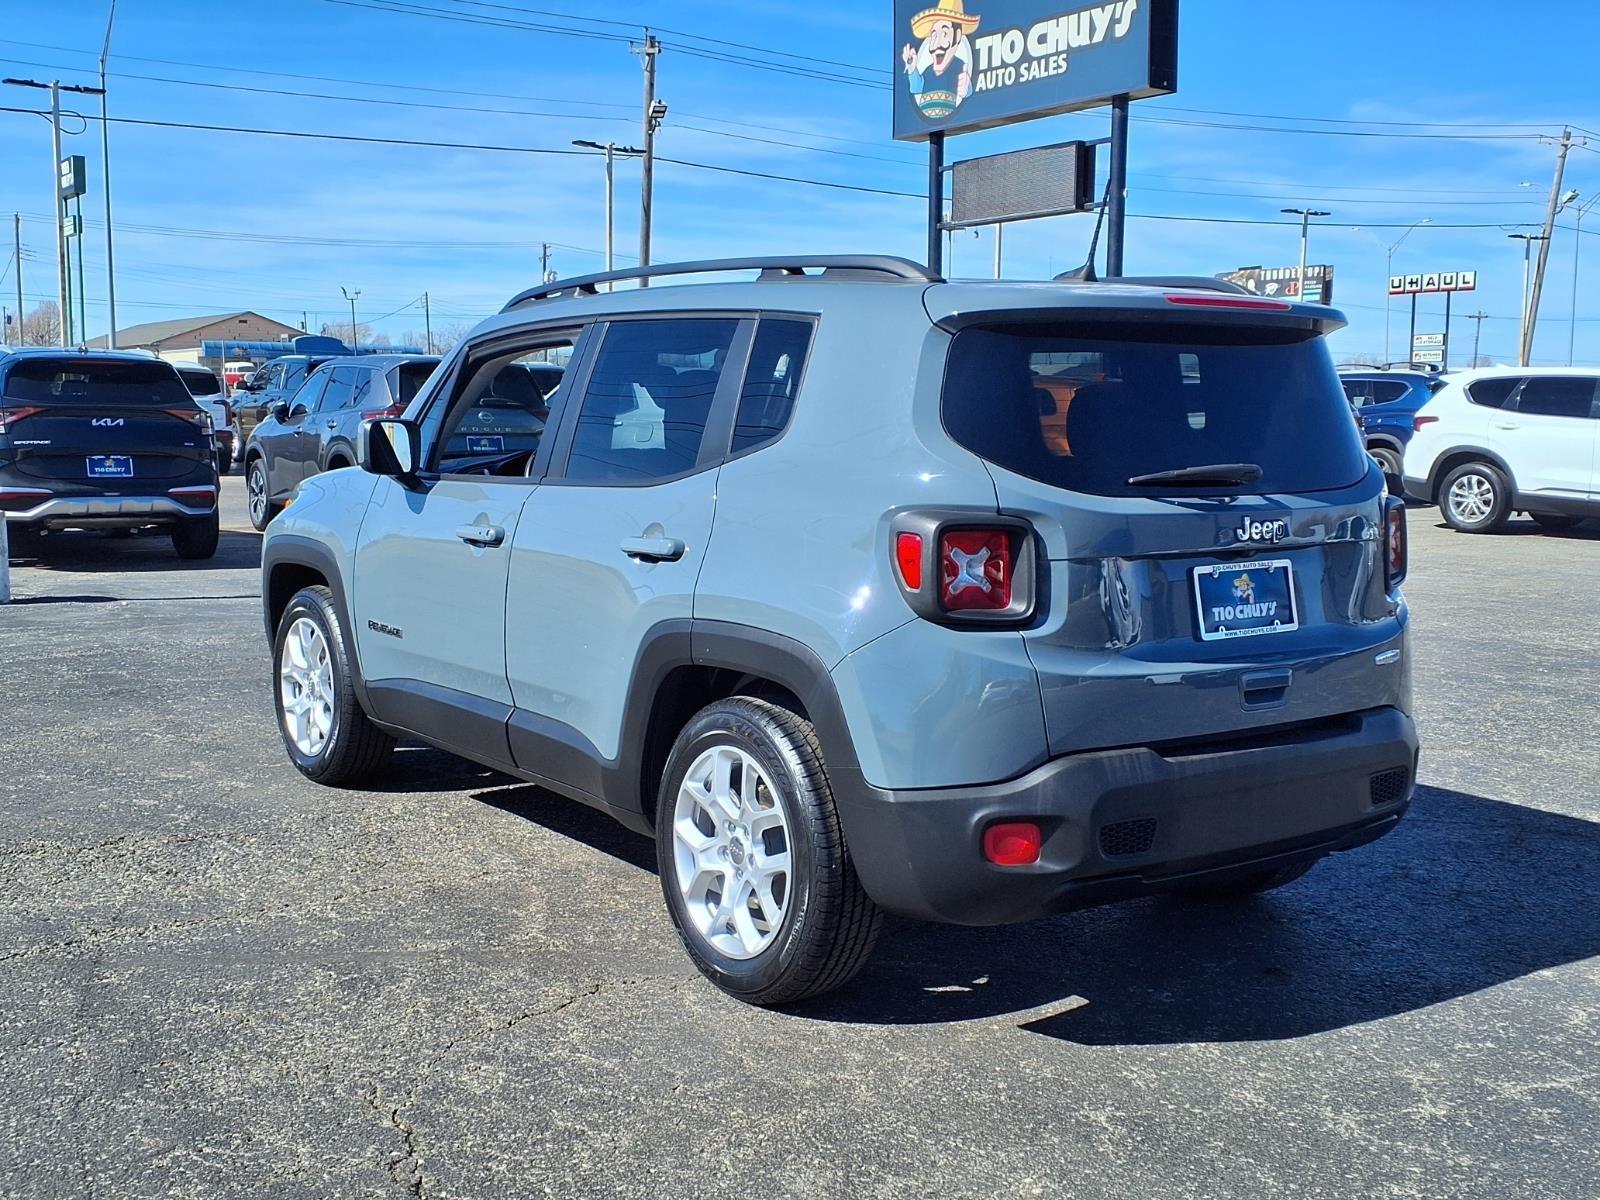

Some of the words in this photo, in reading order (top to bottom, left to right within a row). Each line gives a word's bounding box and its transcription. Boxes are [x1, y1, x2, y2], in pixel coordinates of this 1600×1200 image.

[975, 29, 1025, 70] TIO
[1026, 0, 1137, 57] CHUY'S
[975, 66, 1016, 92] AUTO
[1019, 53, 1068, 83] SALES
[1236, 516, 1285, 543] Jeep
[1212, 606, 1235, 622] TIO
[1235, 601, 1277, 619] CHUY'S
